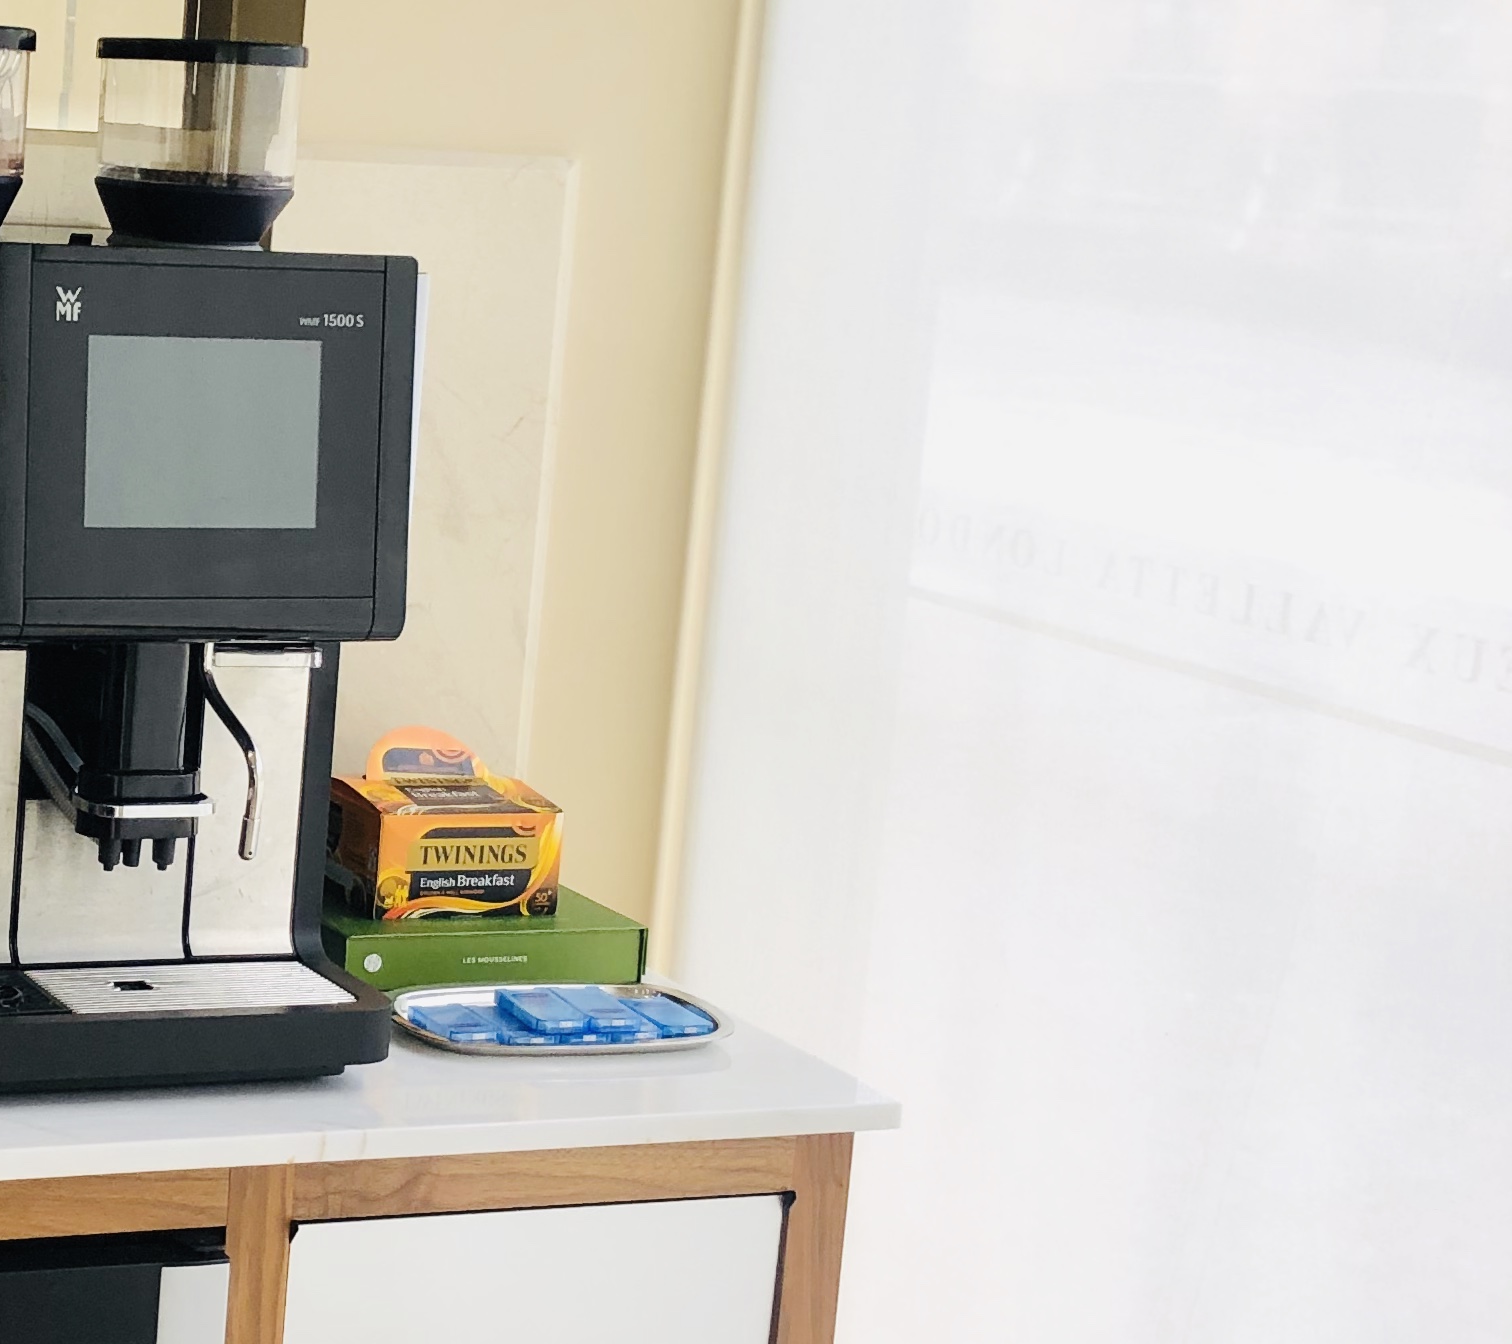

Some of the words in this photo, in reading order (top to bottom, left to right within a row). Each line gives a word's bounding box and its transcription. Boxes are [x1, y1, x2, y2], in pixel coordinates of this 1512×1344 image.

[420, 844, 527, 865] TWININGS
[420, 877, 455, 889] English
[457, 874, 515, 887] Breakfast
